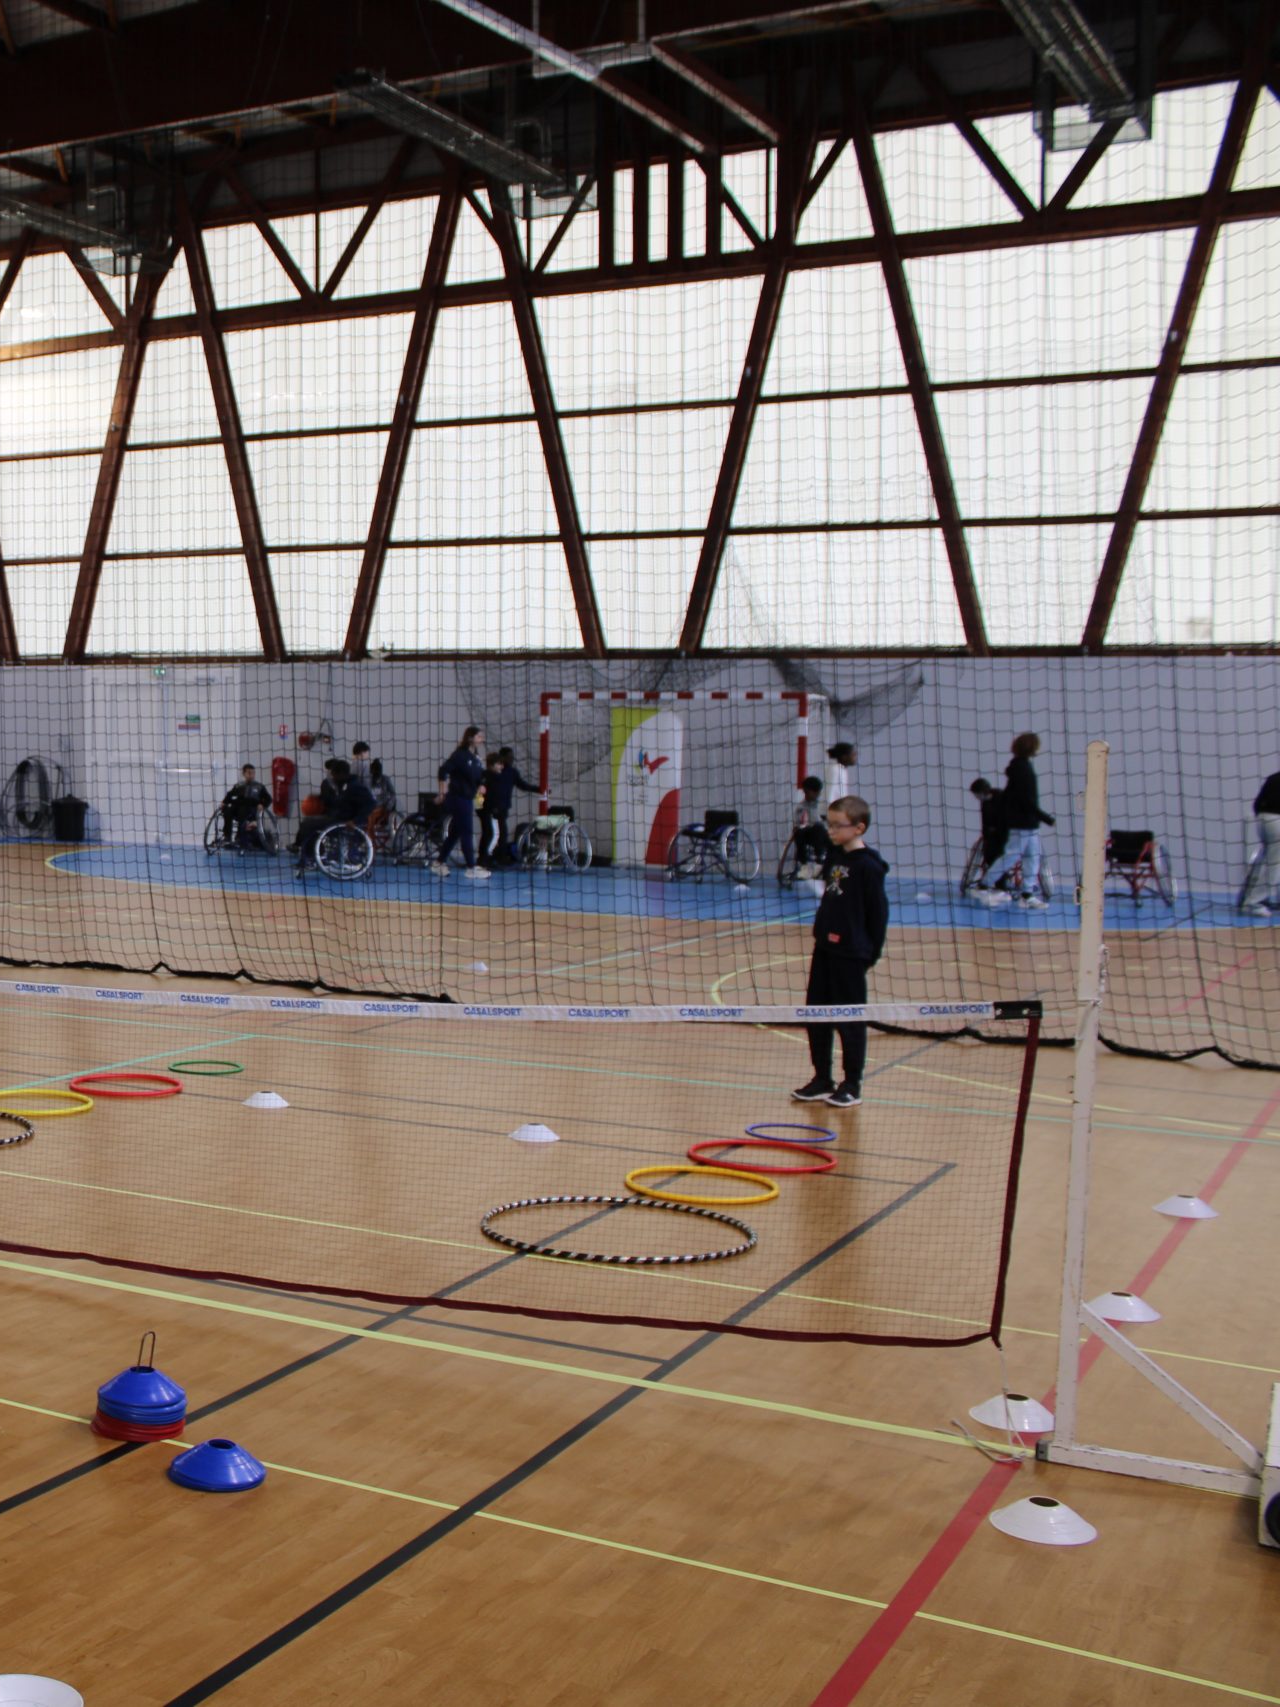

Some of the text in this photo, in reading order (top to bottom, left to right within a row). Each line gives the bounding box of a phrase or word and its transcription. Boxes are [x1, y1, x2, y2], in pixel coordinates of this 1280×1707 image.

[15, 983, 61, 994] CASALSPORT
[95, 990, 144, 1000] CASALSPORT
[180, 994, 231, 1005] CASALSPORT
[270, 1000, 322, 1009] CASALSPORT
[363, 1003, 420, 1013] CASALSPORT
[464, 1007, 522, 1016] CASALSPORT
[568, 1008, 631, 1018] CASALSPORT
[680, 1008, 745, 1017] CASALSPORT
[795, 1008, 865, 1017] CASALSPORT
[919, 1004, 992, 1016] CASALSPORT
